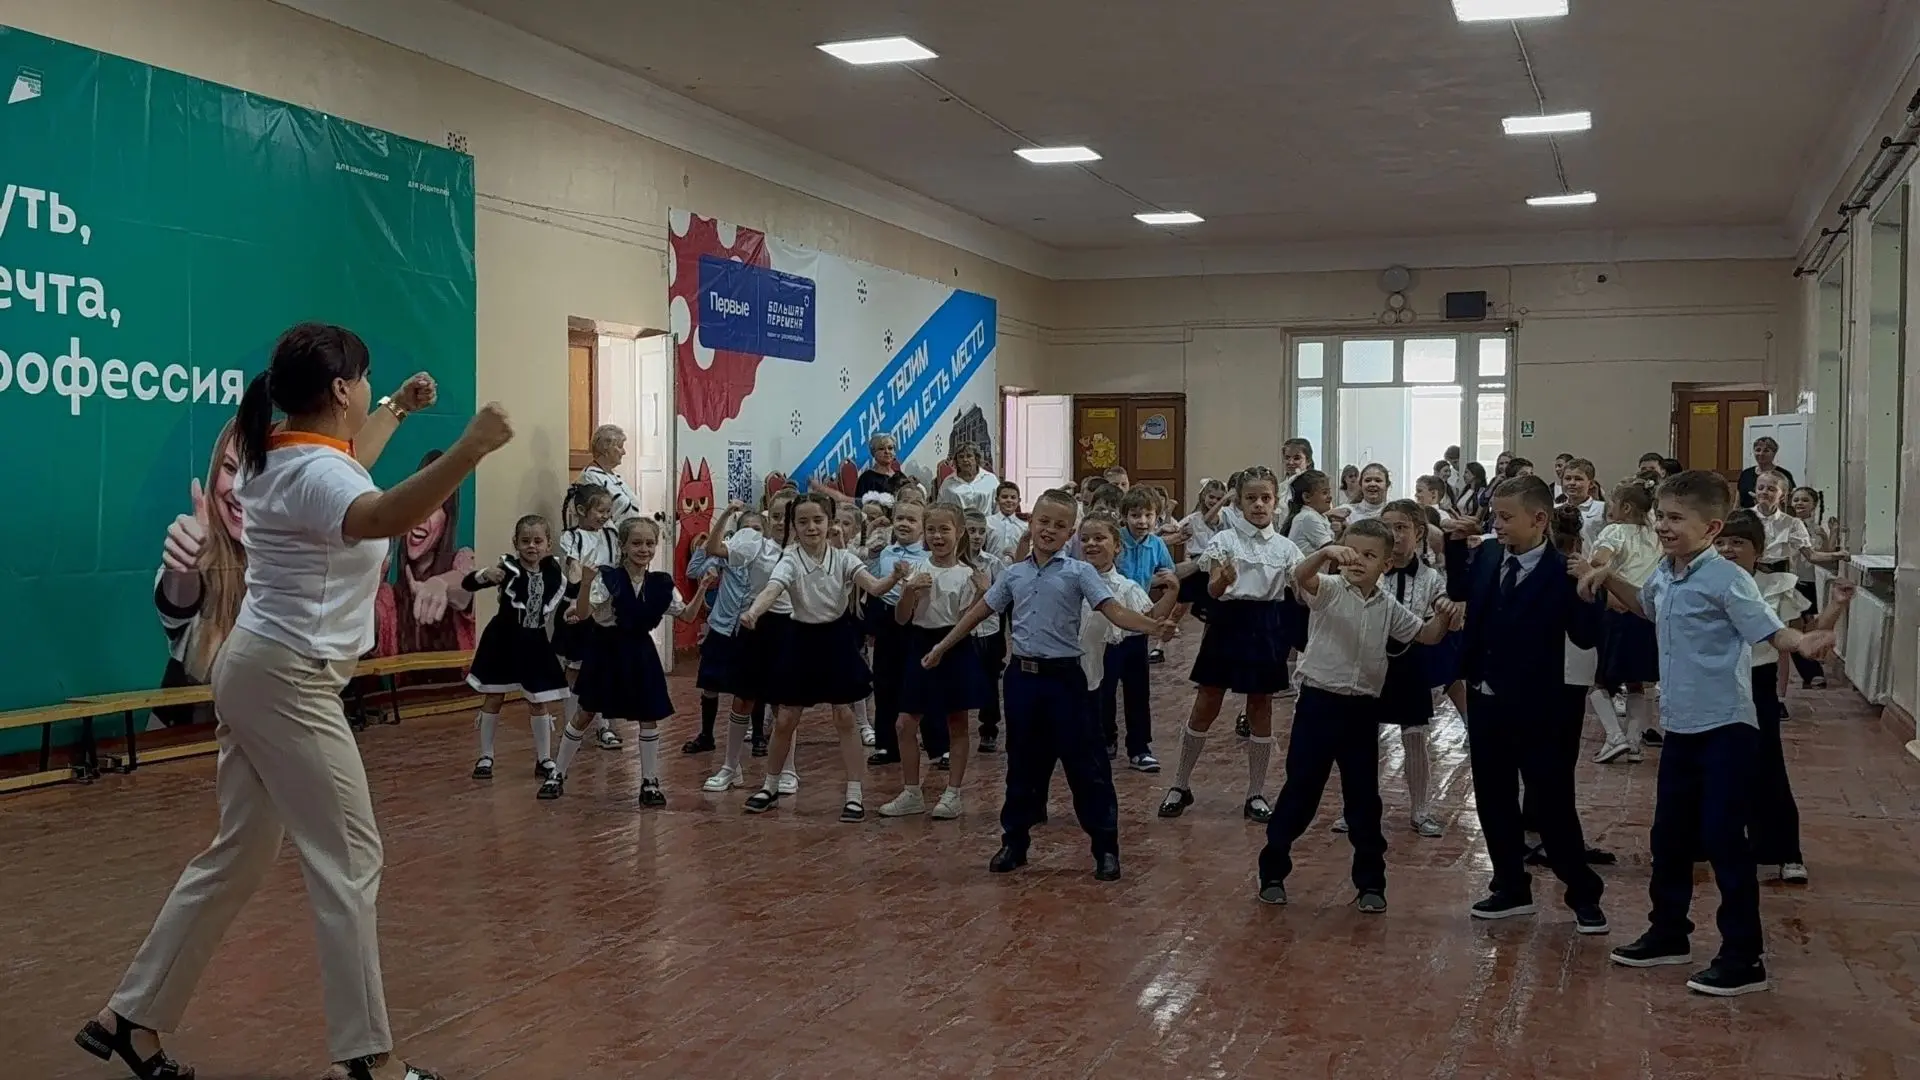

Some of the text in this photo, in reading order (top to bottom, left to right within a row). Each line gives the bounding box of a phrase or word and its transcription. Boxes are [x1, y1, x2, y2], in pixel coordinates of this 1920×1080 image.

[710, 291, 750, 319] Первые
[767, 301, 805, 317] БОЛЬШАЯ
[766, 313, 803, 330] ПЕРЕМЕНА
[921, 367, 950, 418] ЕСТЬ
[951, 319, 985, 382] МЕСТО
[859, 390, 886, 446] ГДЕ
[888, 339, 929, 406] ТВОИМ
